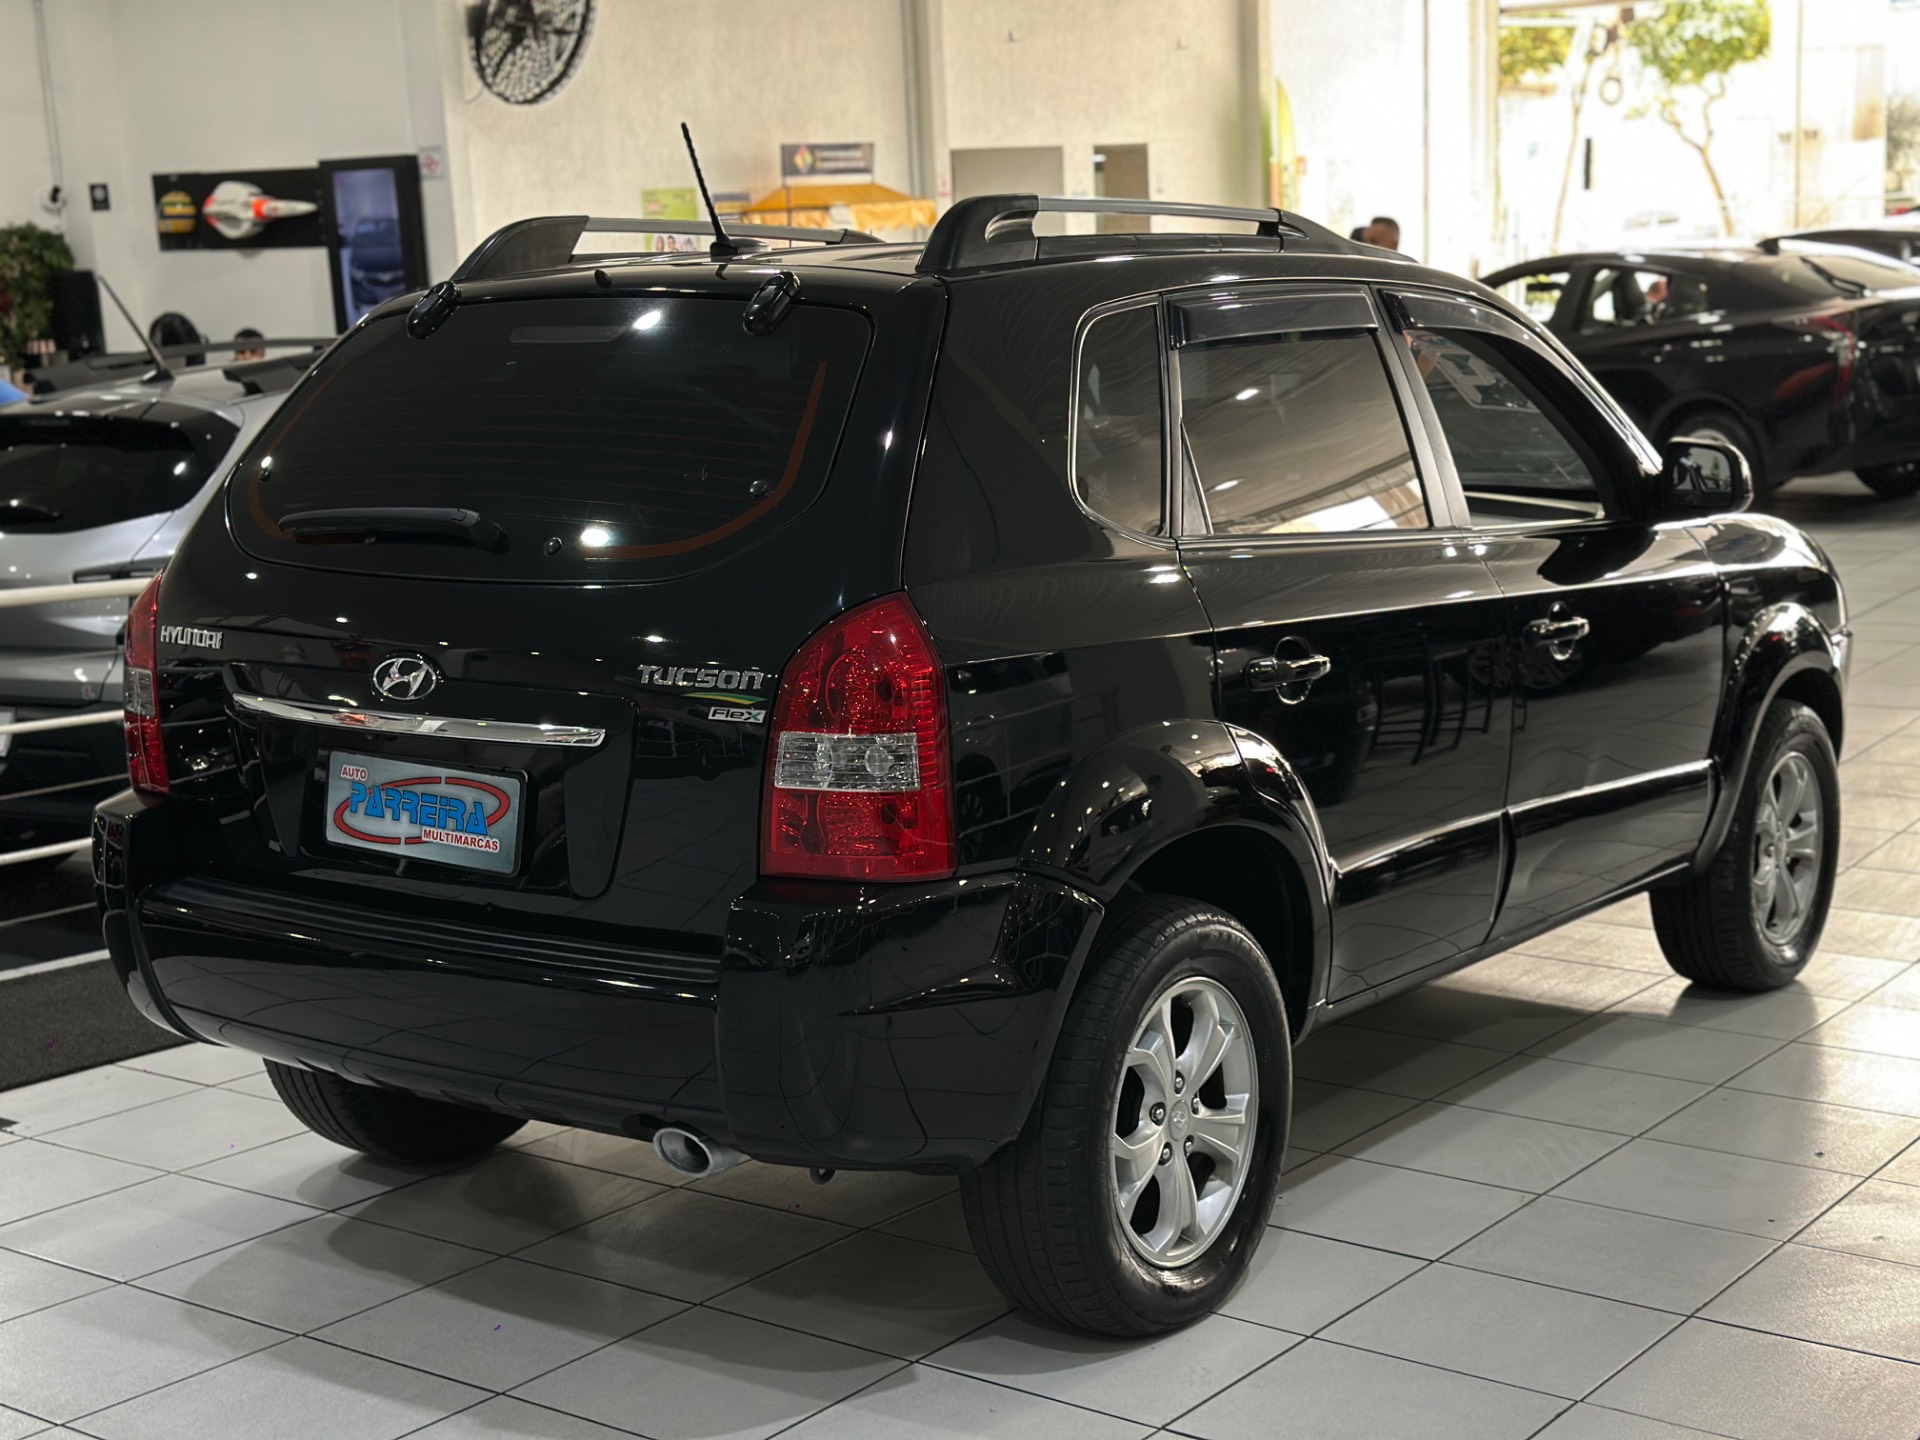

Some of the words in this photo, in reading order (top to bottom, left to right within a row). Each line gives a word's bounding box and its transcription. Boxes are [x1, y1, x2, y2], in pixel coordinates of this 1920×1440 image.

[160, 625, 223, 650] HYUNDAI
[341, 765, 367, 780] AUTO
[350, 781, 488, 836] PARREIRA
[423, 828, 499, 851] MULTIMARCAS
